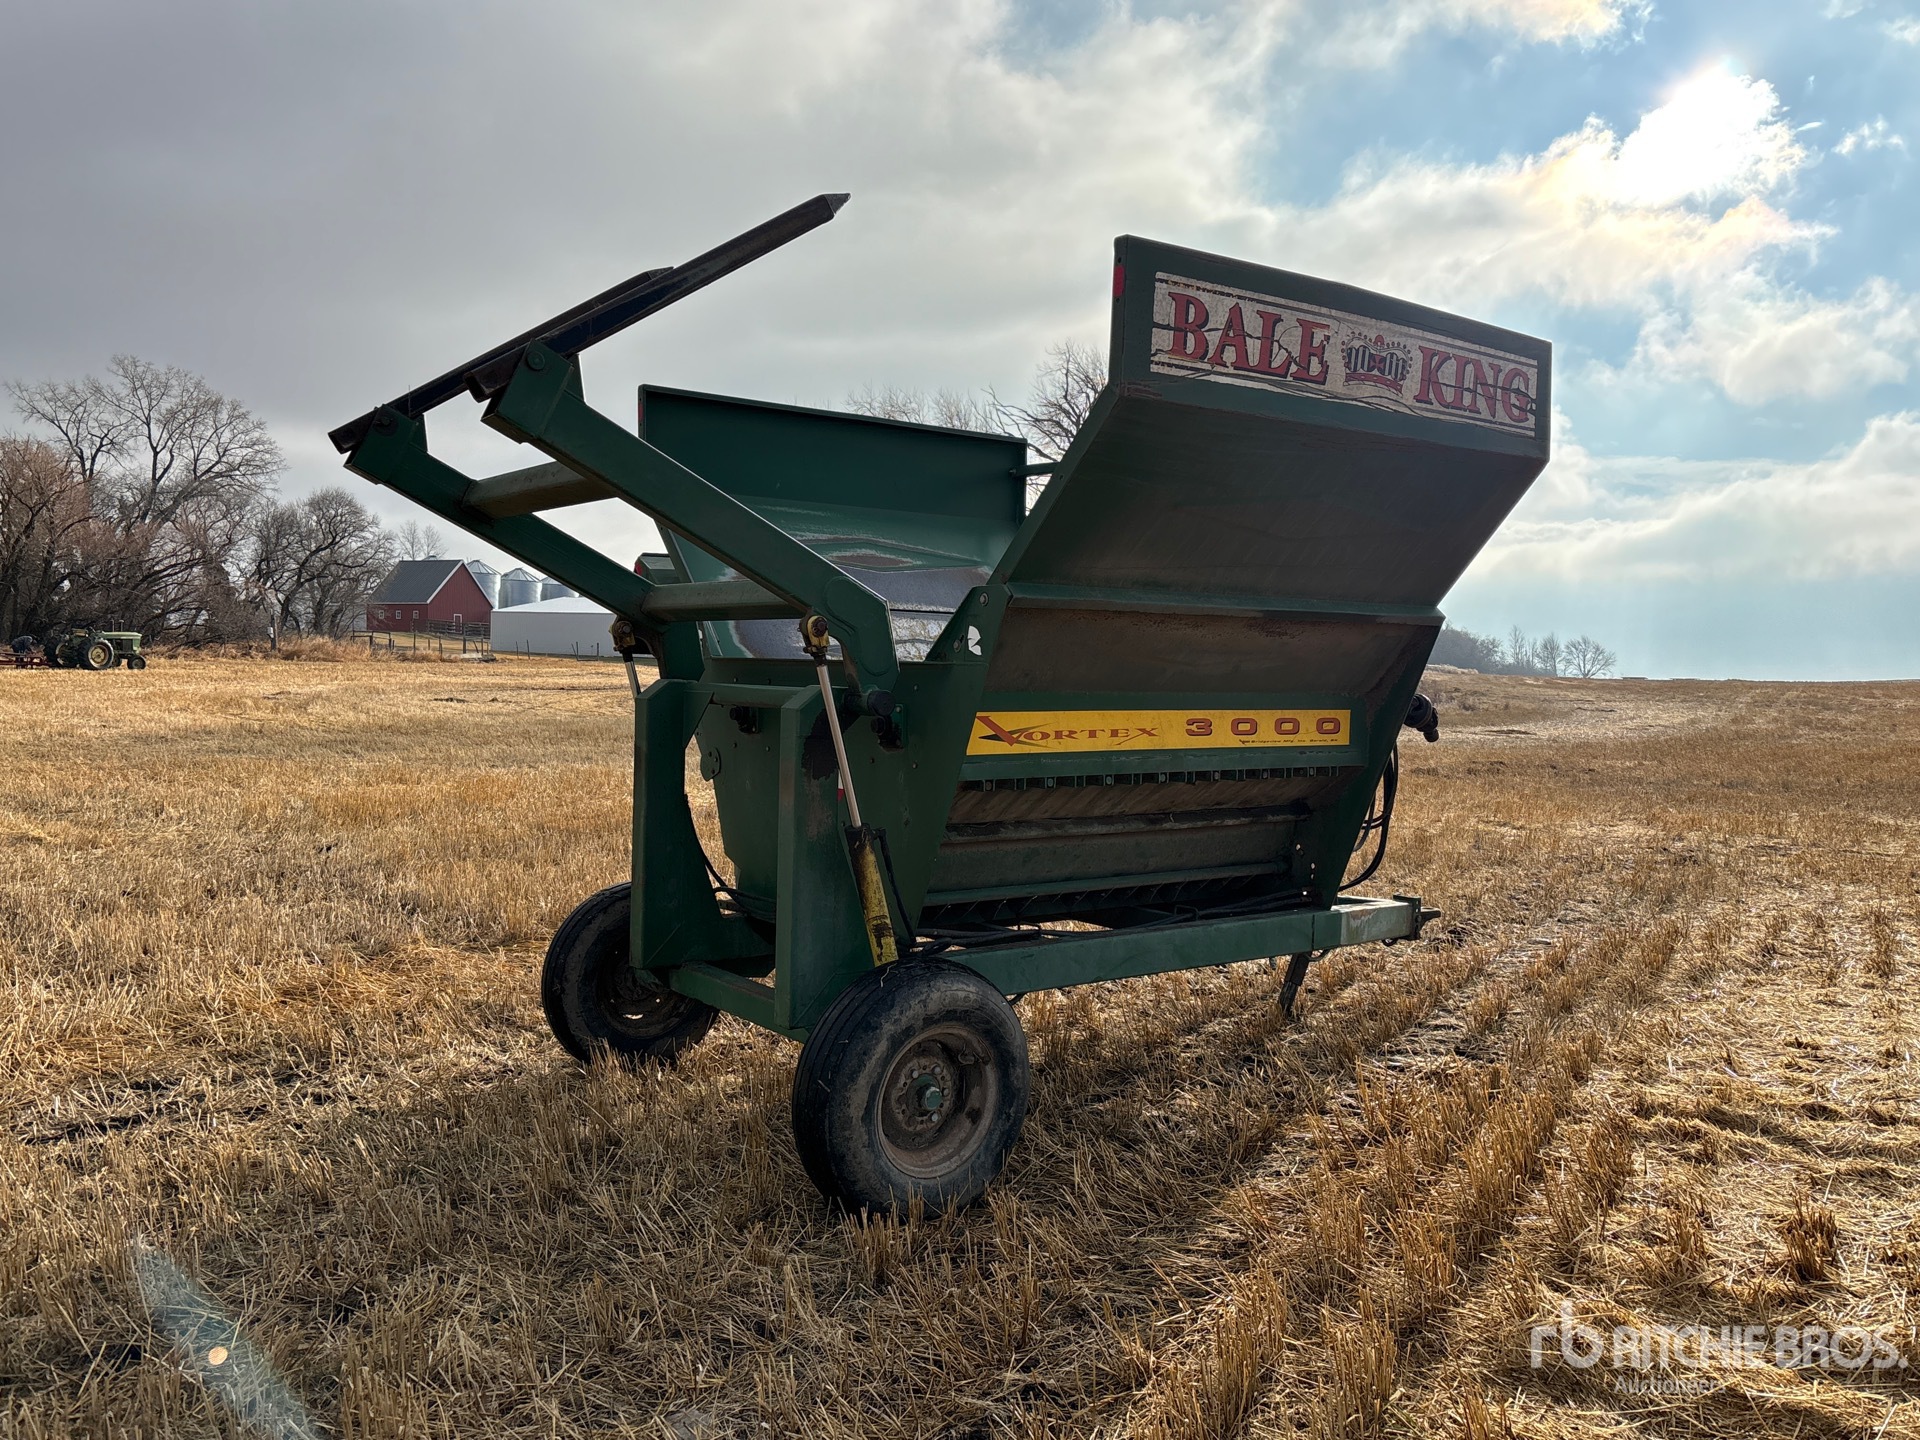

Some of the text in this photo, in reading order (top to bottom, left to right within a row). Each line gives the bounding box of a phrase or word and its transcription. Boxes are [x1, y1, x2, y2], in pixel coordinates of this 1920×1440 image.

[1167, 291, 1531, 423] BALE KING
[976, 716, 1341, 747] VORTEX 3000
